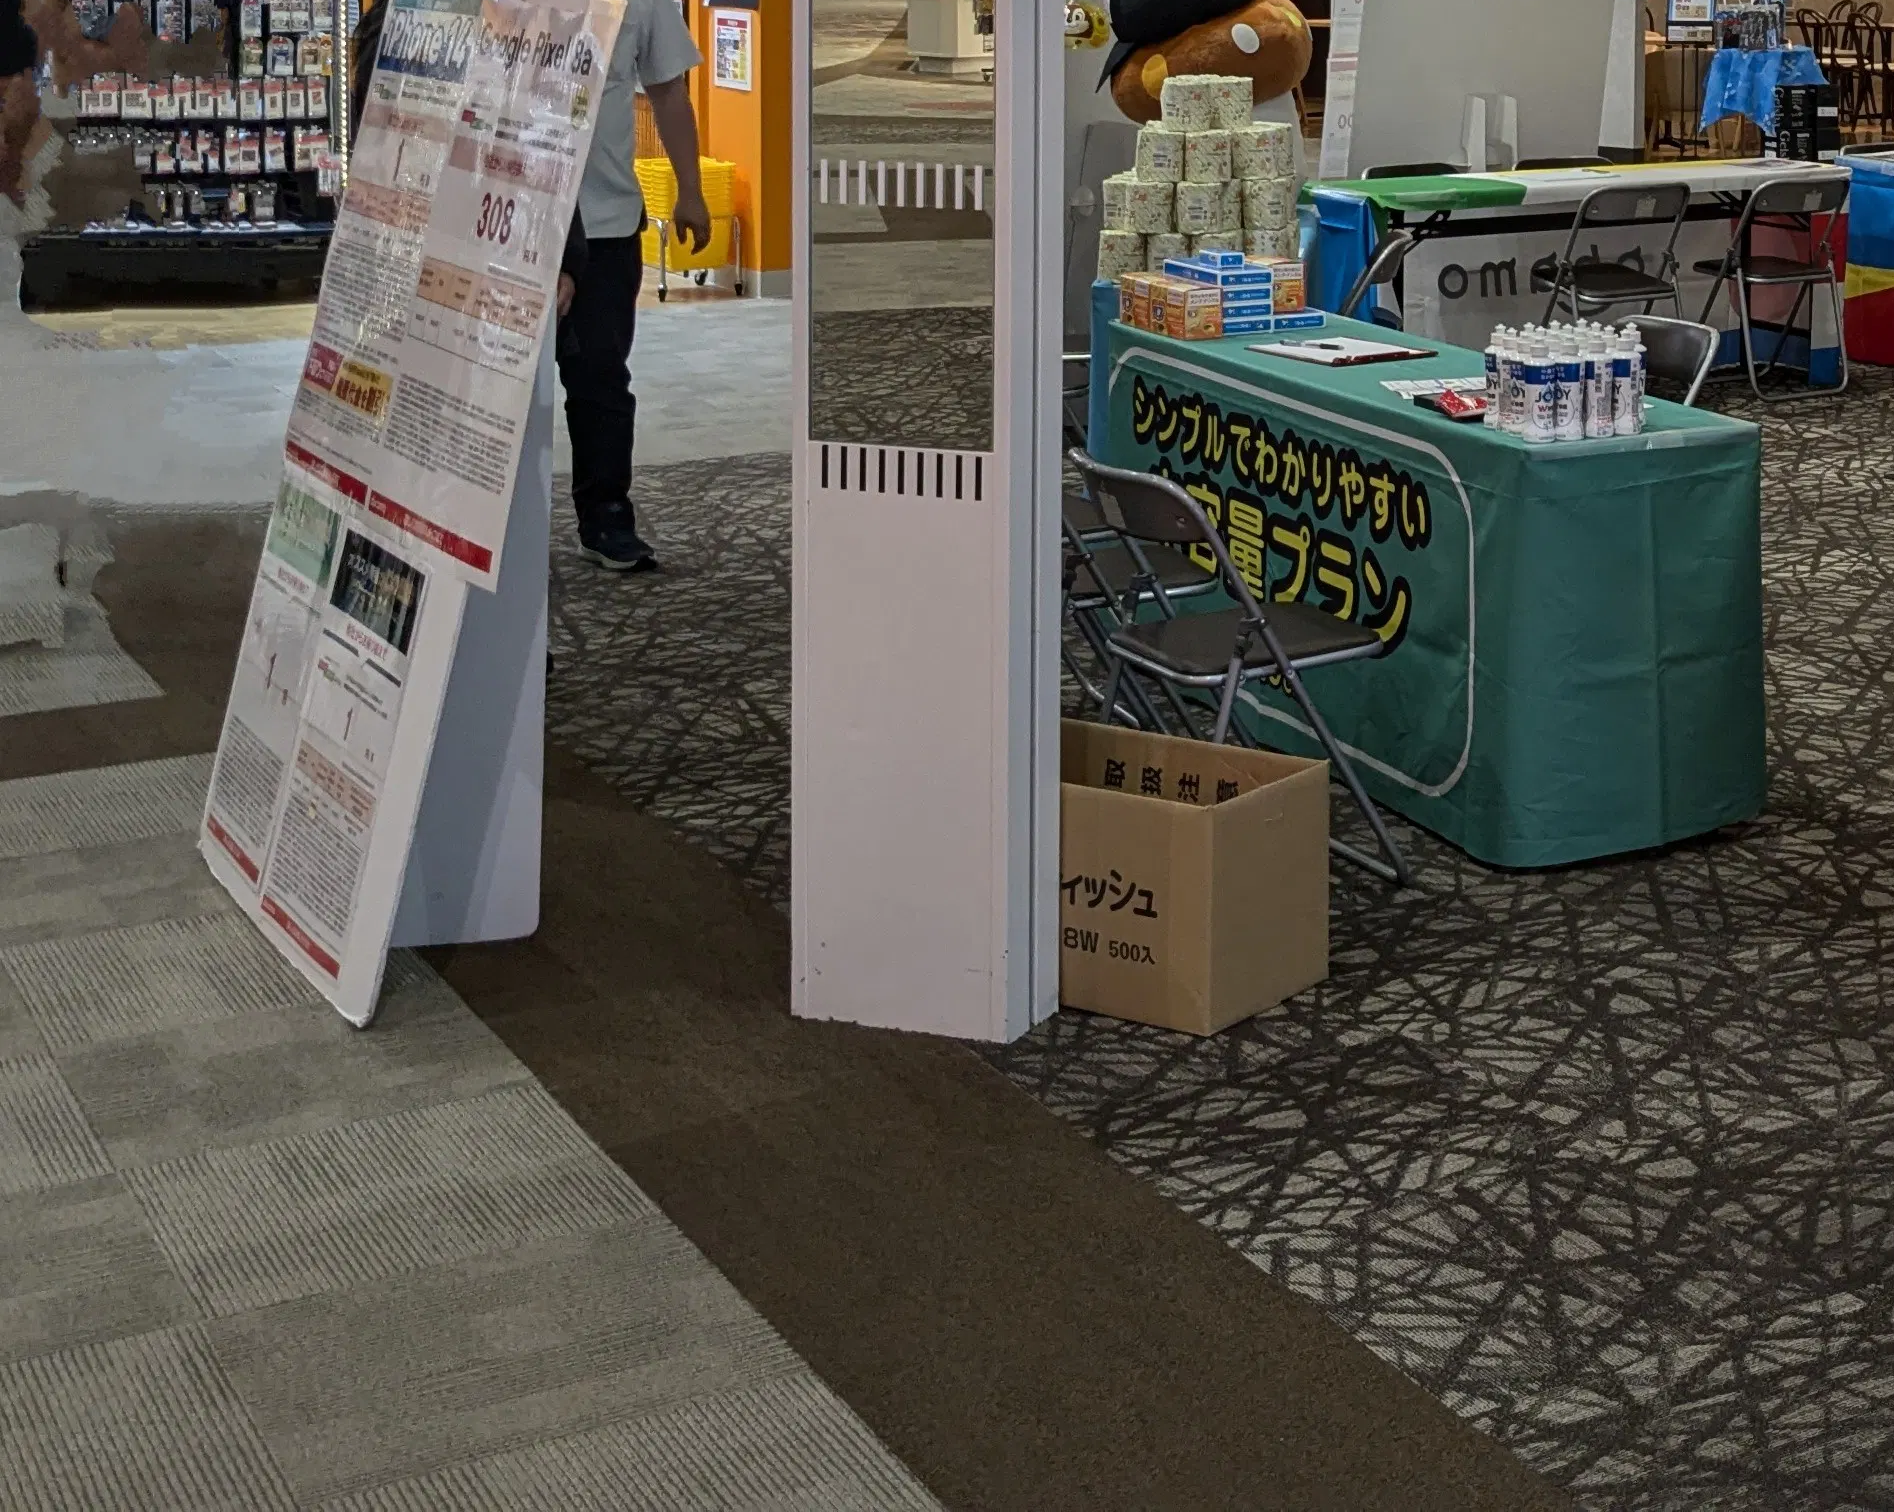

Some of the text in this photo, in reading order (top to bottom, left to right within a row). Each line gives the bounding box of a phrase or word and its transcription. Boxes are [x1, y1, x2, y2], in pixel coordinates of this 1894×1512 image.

[382, 7, 475, 69] iPhone 14
[478, 21, 593, 76] Google Pixel 8a
[476, 191, 516, 245] 308
[1134, 384, 1427, 540] シンプルでわかりやすい
